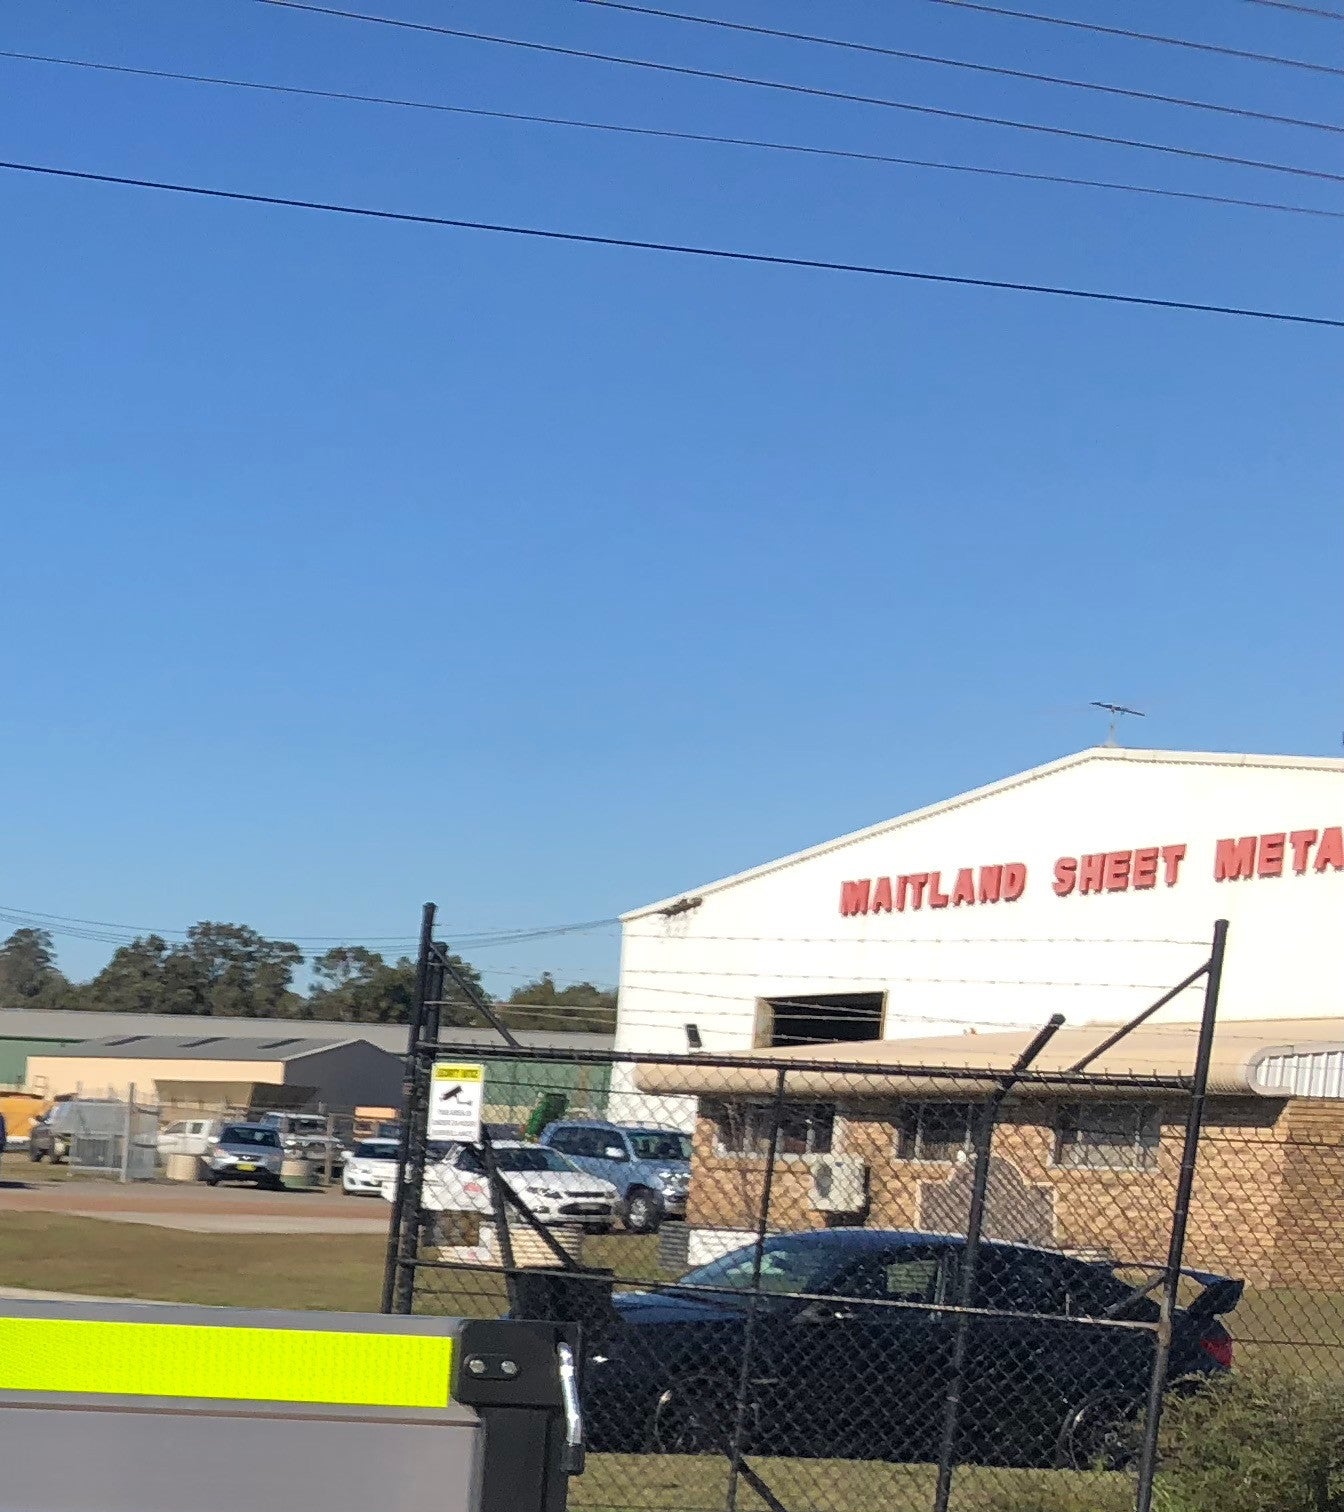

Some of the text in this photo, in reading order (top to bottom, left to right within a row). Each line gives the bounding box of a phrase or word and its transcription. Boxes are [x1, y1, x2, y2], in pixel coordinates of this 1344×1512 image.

[838, 826, 1344, 917] MAITLAND SHEET META
